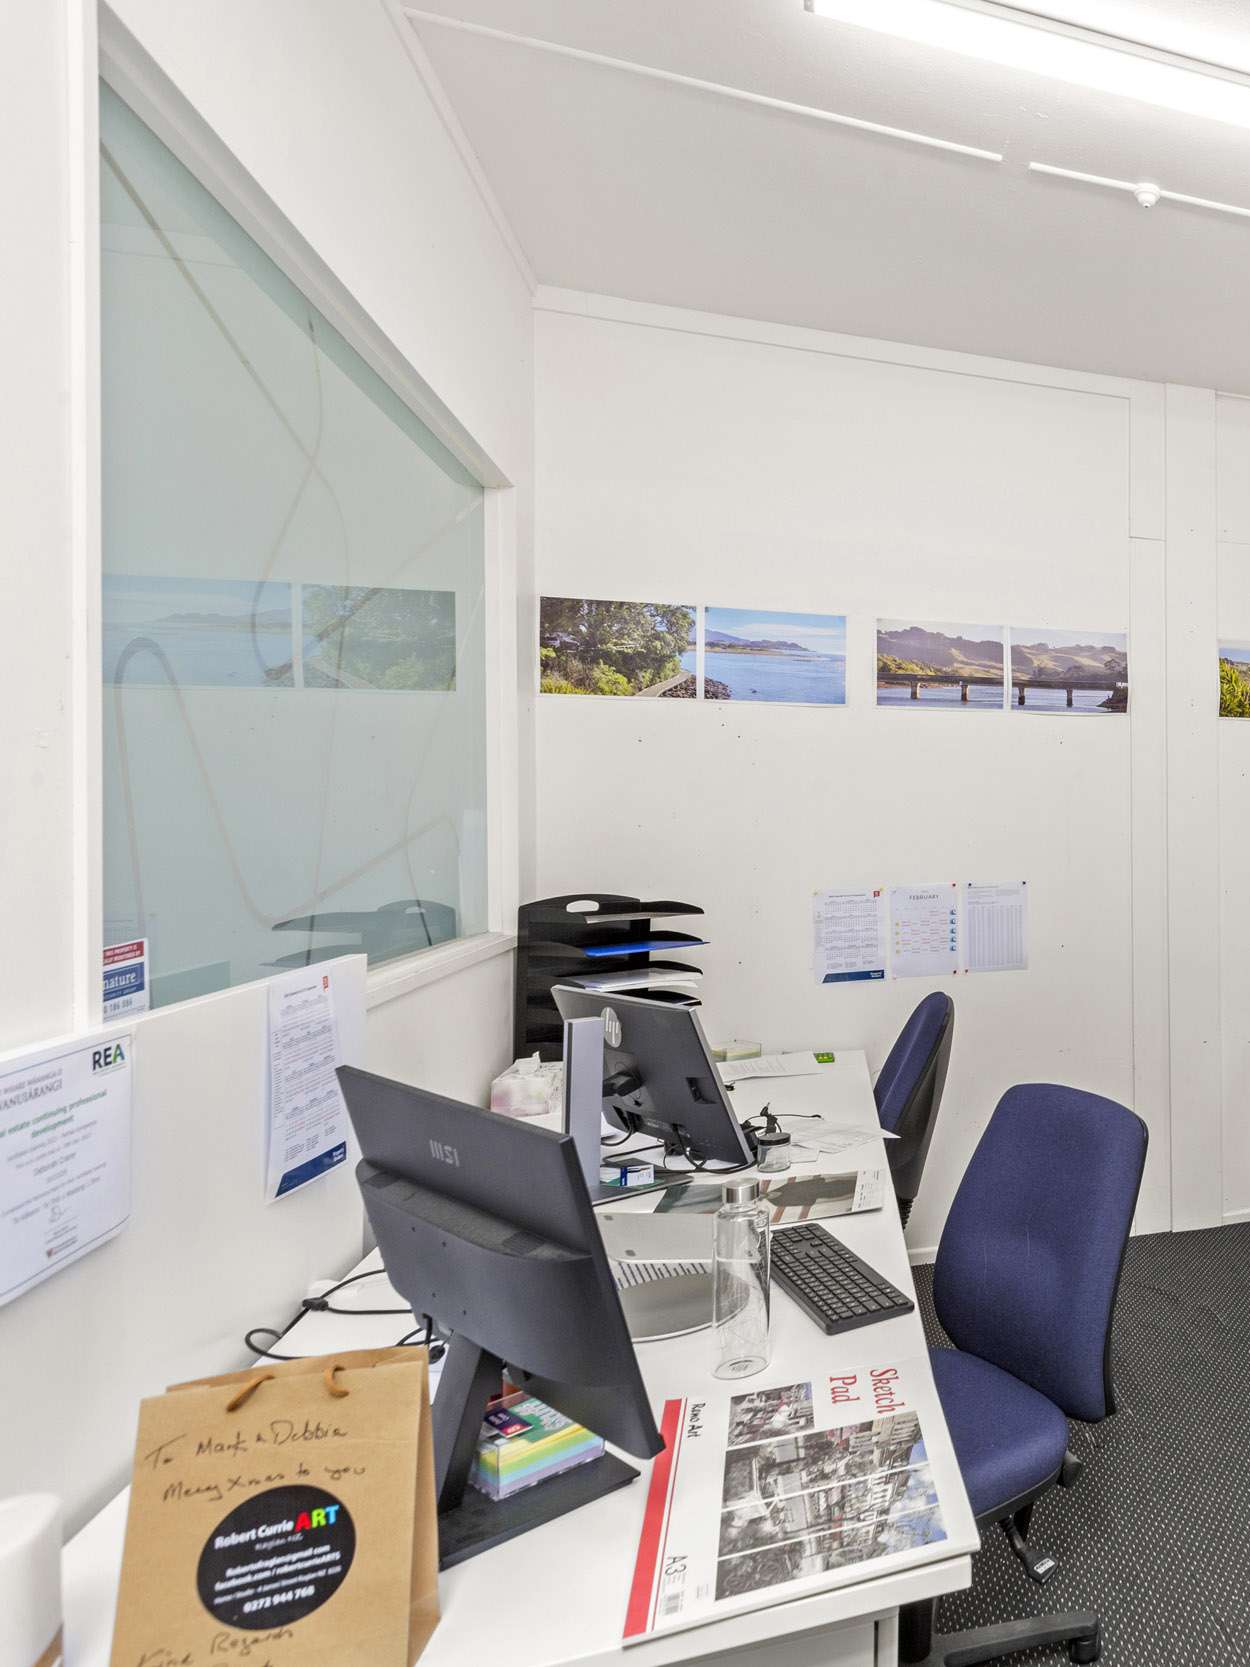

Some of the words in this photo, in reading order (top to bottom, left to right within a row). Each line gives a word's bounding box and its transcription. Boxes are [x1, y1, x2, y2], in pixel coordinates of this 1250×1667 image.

[103, 972, 137, 990] nature
[604, 1006, 620, 1045] hp
[92, 1044, 125, 1071] REA
[430, 1139, 460, 1168] MSI
[830, 1374, 861, 1404] Pad
[870, 1368, 905, 1414] Sketch
[687, 1425, 703, 1439] Art
[144, 1433, 188, 1469] To
[196, 1431, 249, 1457] Mark
[297, 1462, 310, 1478] to
[325, 1466, 366, 1481] you
[214, 1528, 257, 1549] Robert
[257, 1519, 295, 1539] Currie
[294, 1504, 340, 1532] ART
[665, 1555, 689, 1576] A3
[210, 1627, 294, 1657] Regards
